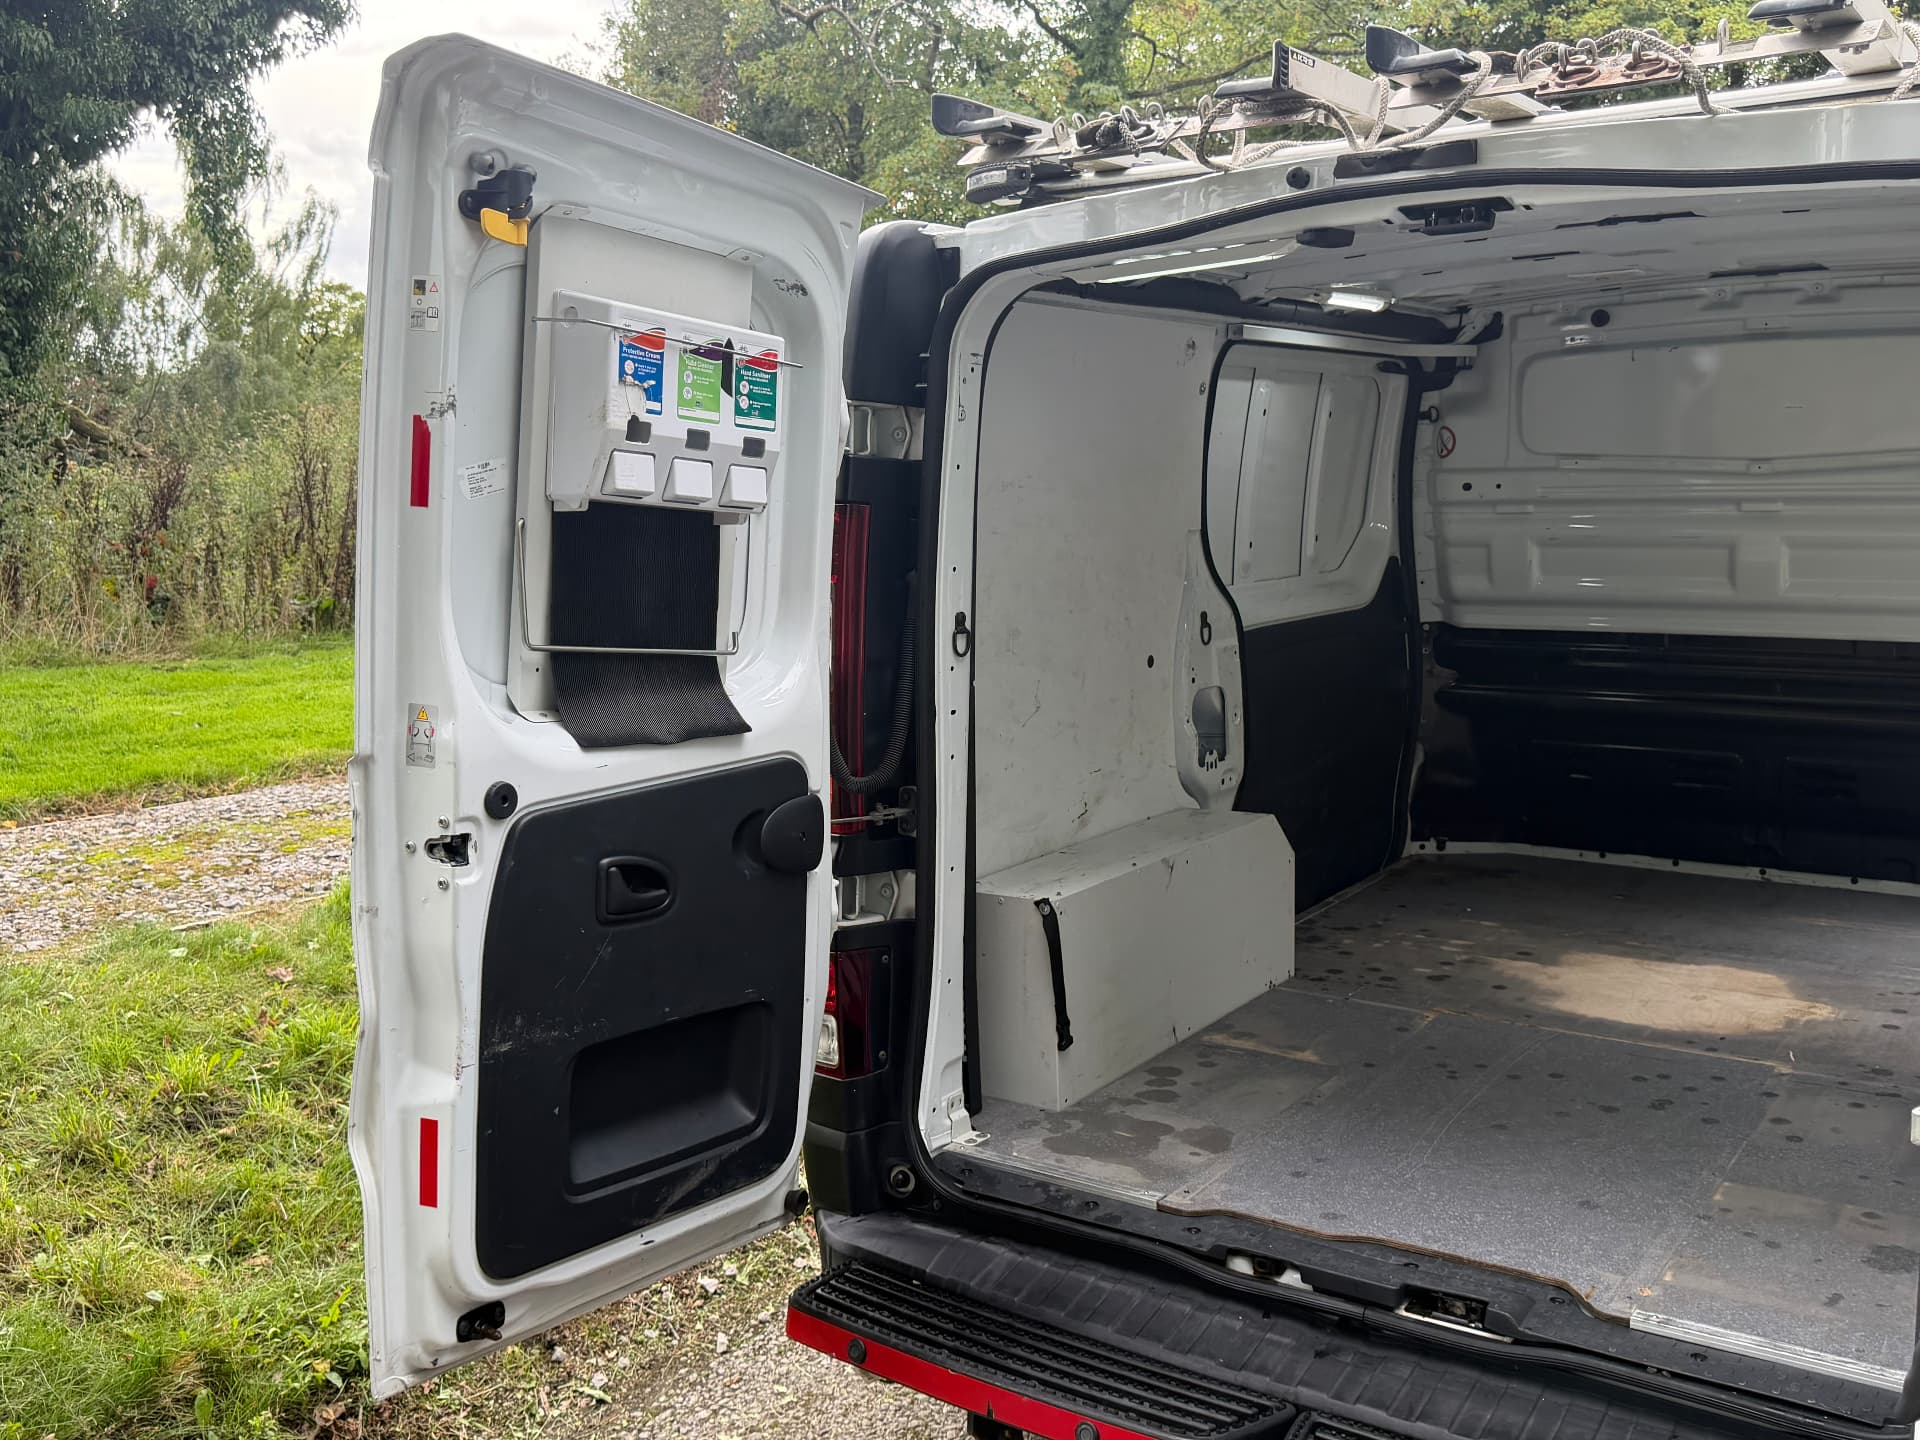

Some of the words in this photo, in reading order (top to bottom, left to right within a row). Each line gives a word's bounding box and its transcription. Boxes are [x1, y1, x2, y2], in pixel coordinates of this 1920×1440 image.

[622, 346, 645, 356] Protective
[646, 351, 661, 360] Cream
[739, 369, 752, 377] Hand
